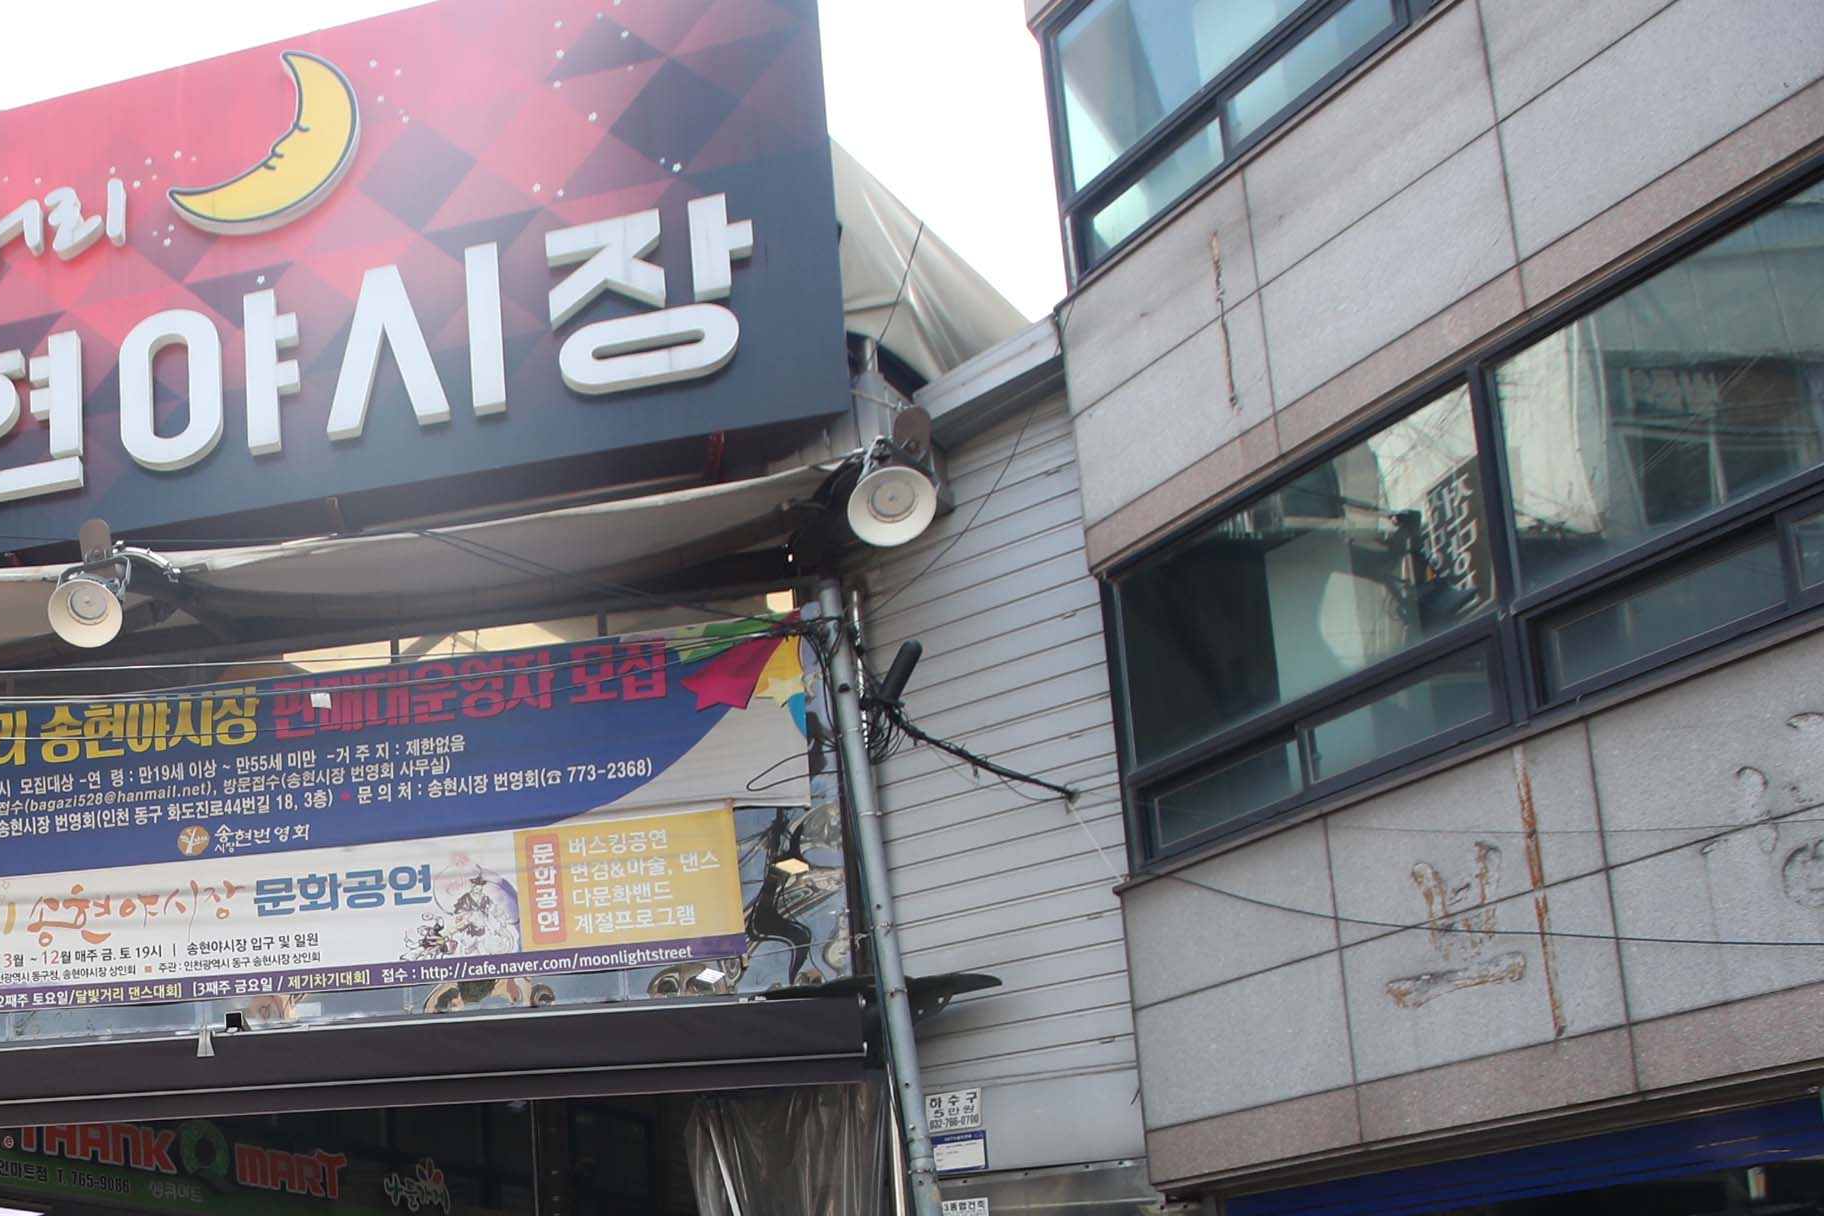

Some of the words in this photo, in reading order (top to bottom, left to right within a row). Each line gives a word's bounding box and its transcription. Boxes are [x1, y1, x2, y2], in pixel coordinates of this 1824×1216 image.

[40, 686, 260, 764] 송현야시장
[570, 641, 668, 705] 모집
[20, 773, 73, 795] 모집대상
[138, 762, 185, 784] 만19세
[189, 759, 217, 779] 이상
[236, 752, 282, 774] 만55세
[288, 750, 316, 770] 미만
[406, 734, 465, 756] 제한없음
[351, 762, 394, 783] 번영회
[400, 756, 451, 778] 사무실)
[427, 775, 488, 798] 송현시장
[134, 805, 163, 826] 동구
[167, 794, 270, 822] 화도진로44번길
[568, 829, 669, 857] 버스킹공연
[679, 850, 720, 873] 댄스
[531, 843, 561, 933] 문화공연
[572, 881, 673, 907] 다문화밴드
[28, 880, 246, 946] 송현야시장
[253, 863, 433, 917] 문화공연
[575, 904, 697, 936] 계절프로그램
[3, 953, 24, 968] 3월
[75, 948, 96, 963] 매주
[134, 944, 163, 959] 19시
[187, 939, 247, 957] 송현야시장
[251, 937, 274, 953] 입구
[278, 935, 290, 951] 및
[294, 932, 319, 949] 일원
[234, 976, 273, 994] 금요일
[381, 967, 408, 983] 접수
[234, 1143, 348, 1200] MART
